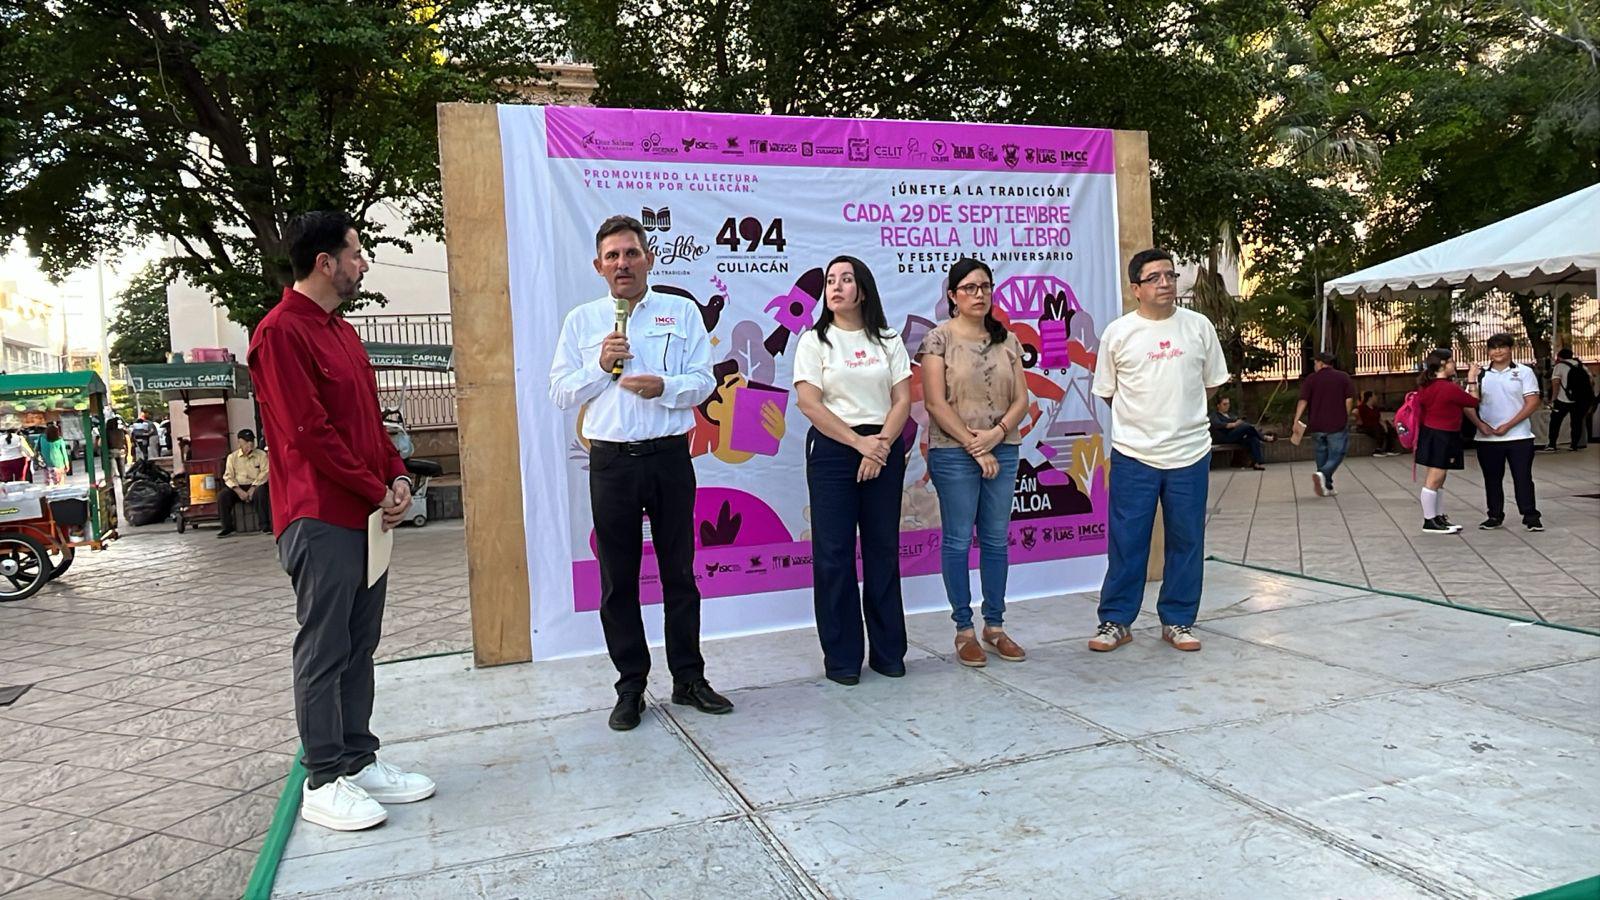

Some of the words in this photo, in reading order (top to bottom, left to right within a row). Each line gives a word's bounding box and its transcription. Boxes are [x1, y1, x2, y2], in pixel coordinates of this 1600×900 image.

[874, 146, 903, 156] CELIT
[1060, 150, 1088, 161] IMCC
[1038, 153, 1057, 163] UAS
[584, 168, 679, 181] PROMOVIENDO
[685, 172, 699, 181] LA
[704, 173, 759, 183] LECTURA
[584, 179, 590, 188] Y
[597, 180, 610, 189] EL
[617, 180, 653, 189] AMOR
[659, 182, 684, 191] POR
[689, 182, 755, 193] CULIACÁN.
[892, 182, 947, 197] ¡ÚNETE
[953, 185, 961, 196] A
[967, 185, 984, 196] LA
[989, 184, 1071, 197] TRADICIÓN!
[842, 203, 895, 223] CADA
[899, 203, 924, 223] 29
[928, 204, 953, 223] DE
[958, 204, 1071, 224] SEPTIEMBRE
[716, 216, 787, 253] 494
[880, 226, 961, 248] REGALA
[973, 226, 998, 248] UN
[1010, 226, 1071, 248] LIBRO
[897, 252, 904, 262] Y
[910, 252, 965, 262] FESTEJA
[972, 252, 985, 261] EL
[991, 251, 1074, 262] ANIVERSARIO
[717, 261, 789, 273] CULIACÁN
[898, 263, 914, 273] DE
[921, 263, 936, 273] LA
[412, 354, 448, 363] CAPITAL
[147, 380, 192, 389] CULIACÁN
[14, 387, 81, 396] LIMONADA
[1011, 493, 1052, 513] ALOA
[1078, 523, 1105, 535] IMCC
[1055, 530, 1074, 541] UAS
